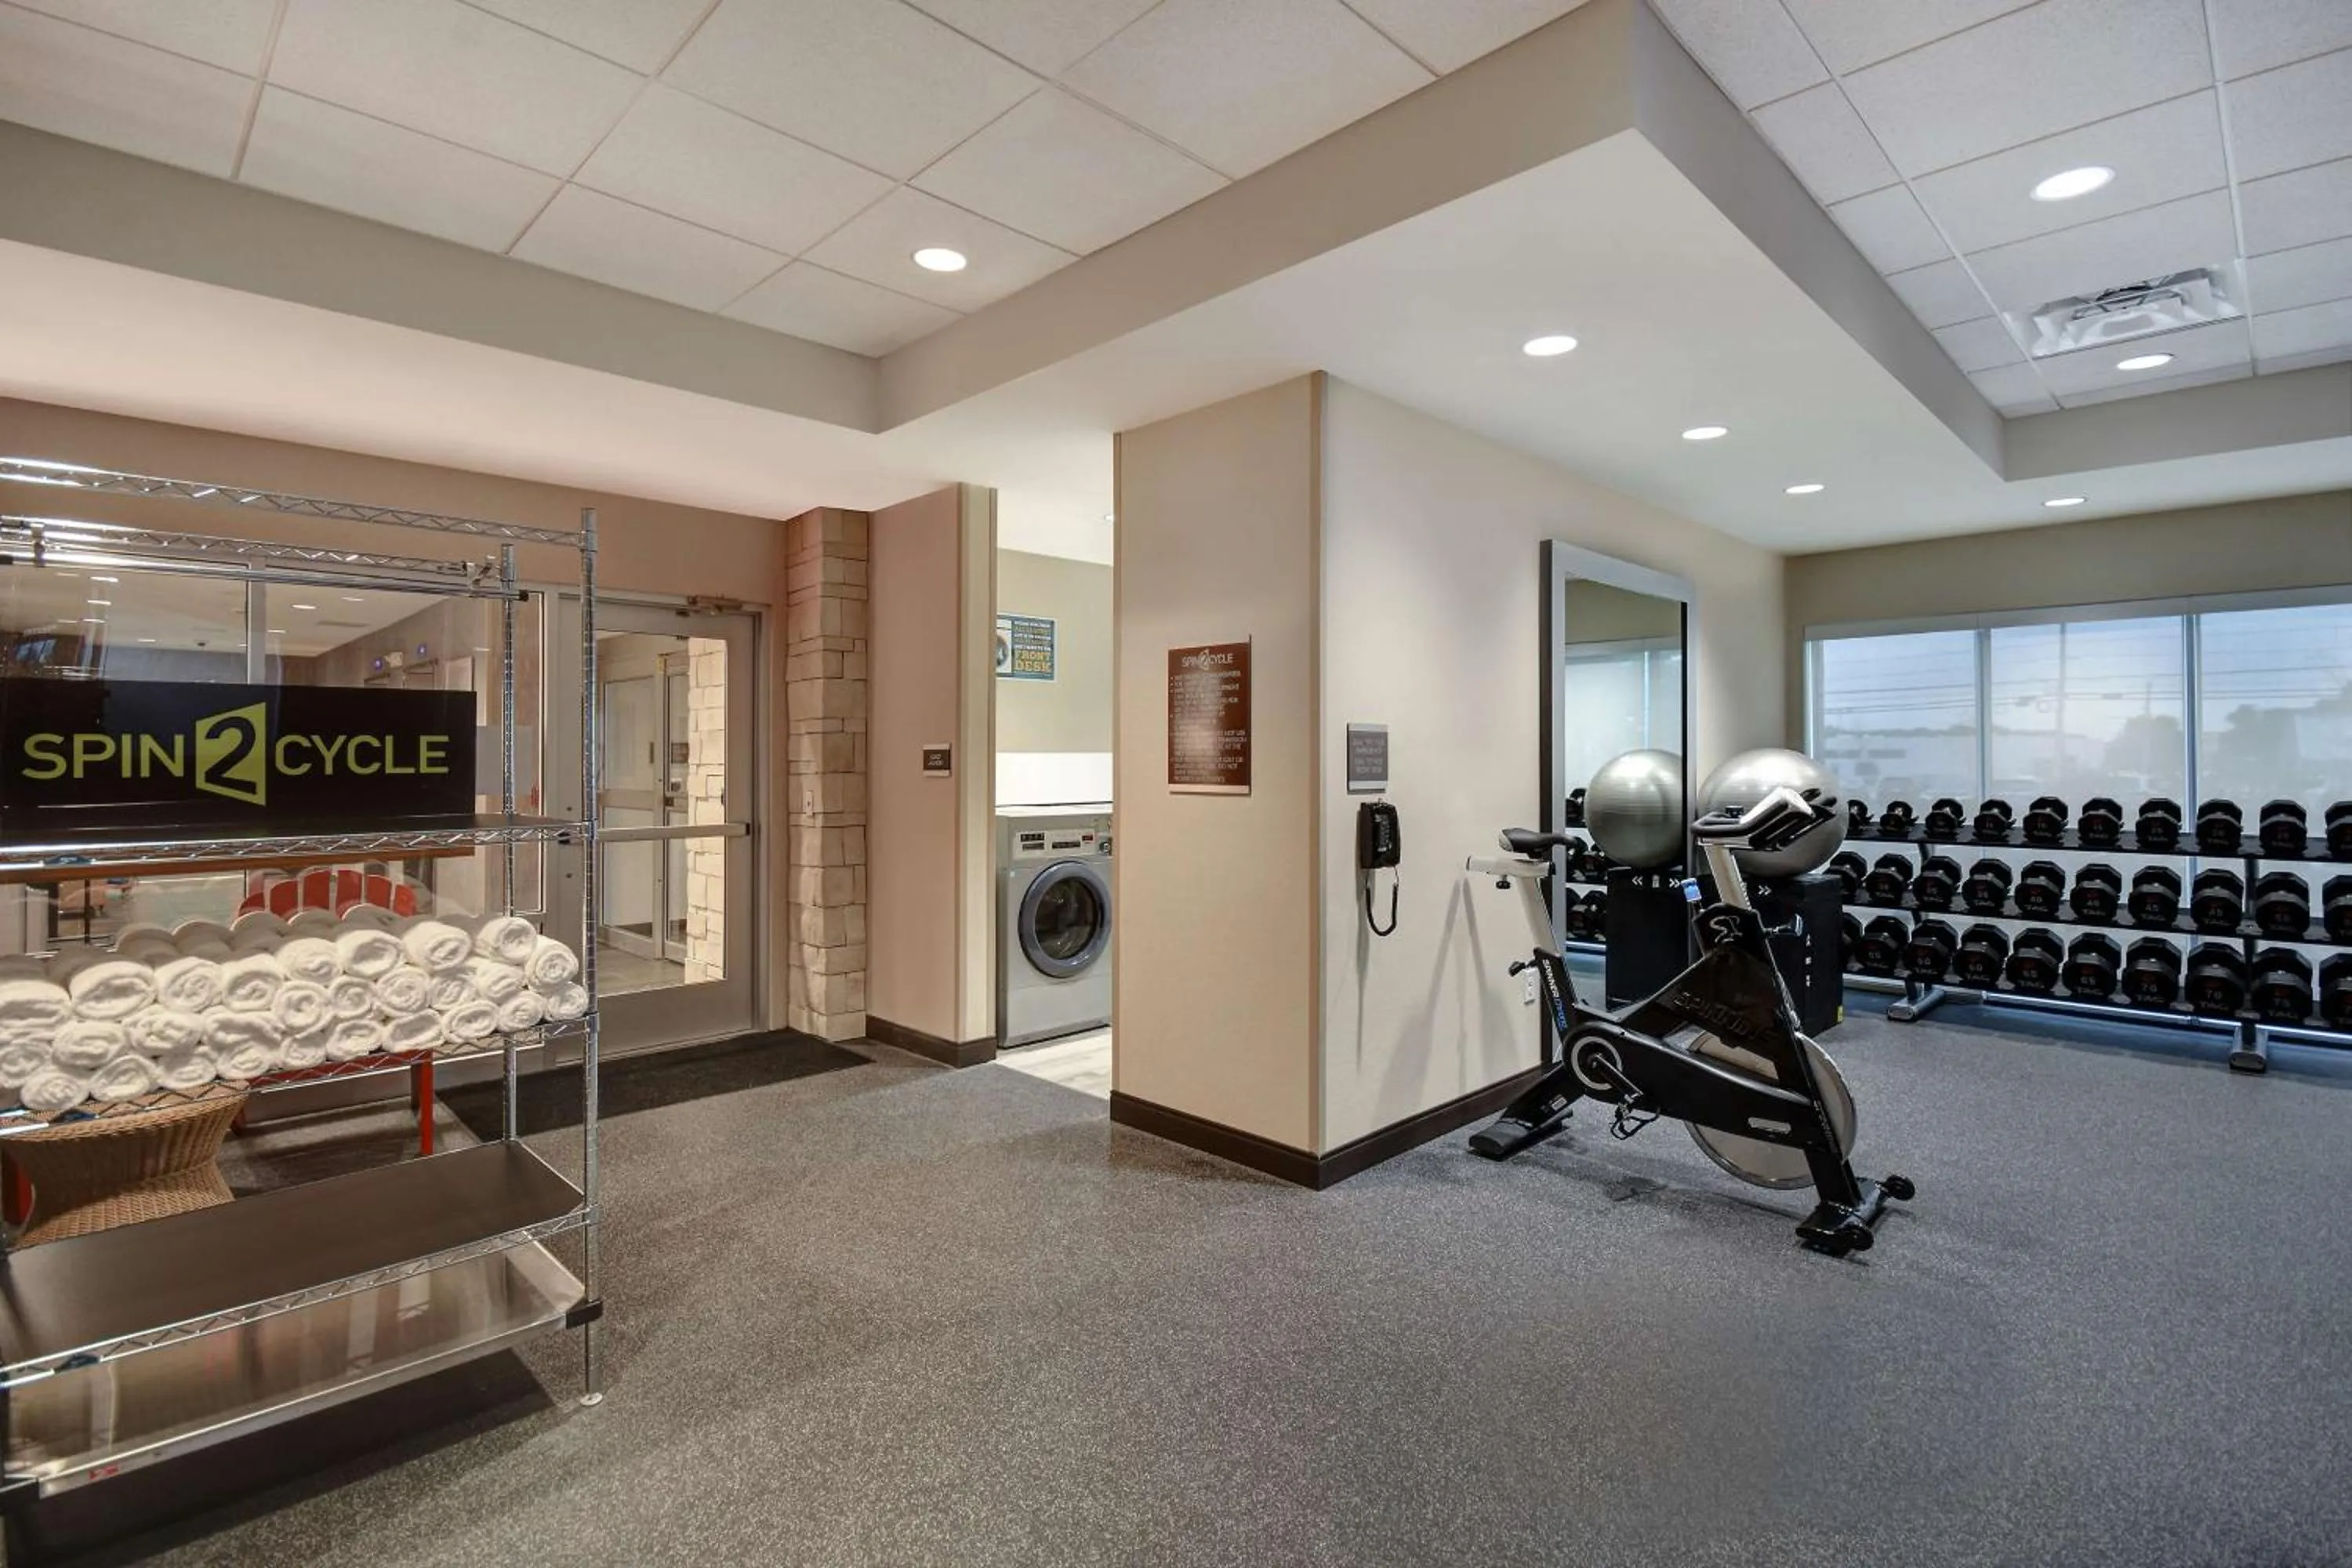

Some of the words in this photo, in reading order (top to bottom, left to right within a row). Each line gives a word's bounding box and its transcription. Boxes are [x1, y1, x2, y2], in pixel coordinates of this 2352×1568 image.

[1014, 650, 1051, 661] FRONT
[1210, 653, 1233, 666] CYCLE
[1014, 660, 1051, 673] DESK
[22, 733, 185, 780] SPIN
[204, 715, 257, 796] 2
[274, 735, 450, 775] CYCLE
